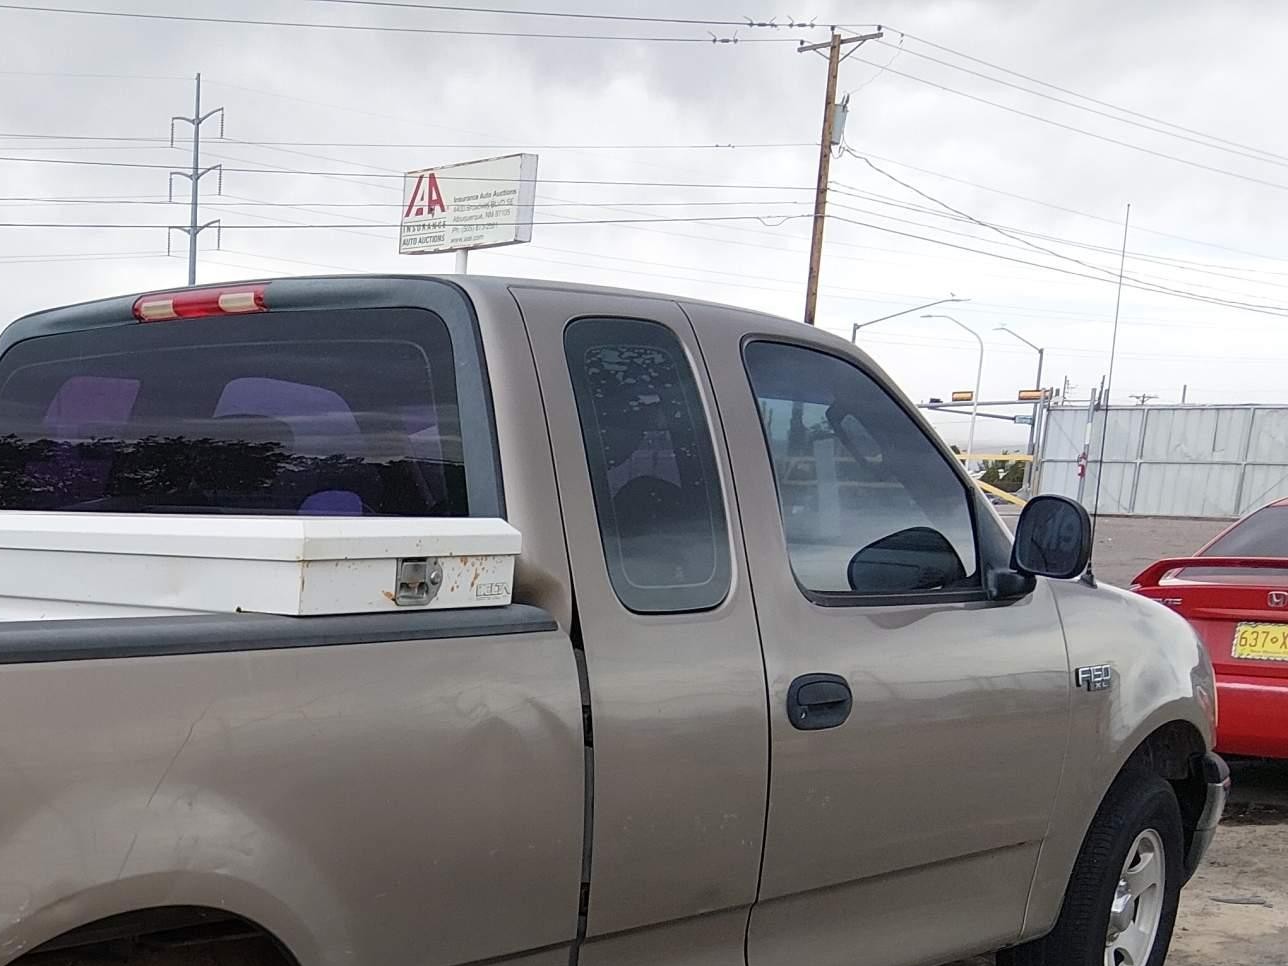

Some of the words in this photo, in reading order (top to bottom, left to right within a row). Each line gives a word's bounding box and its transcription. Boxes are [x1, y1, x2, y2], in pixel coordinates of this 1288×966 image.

[403, 220, 446, 233] INSURANCE
[403, 236, 418, 246] AUTO
[418, 233, 446, 245] AUCTIONS
